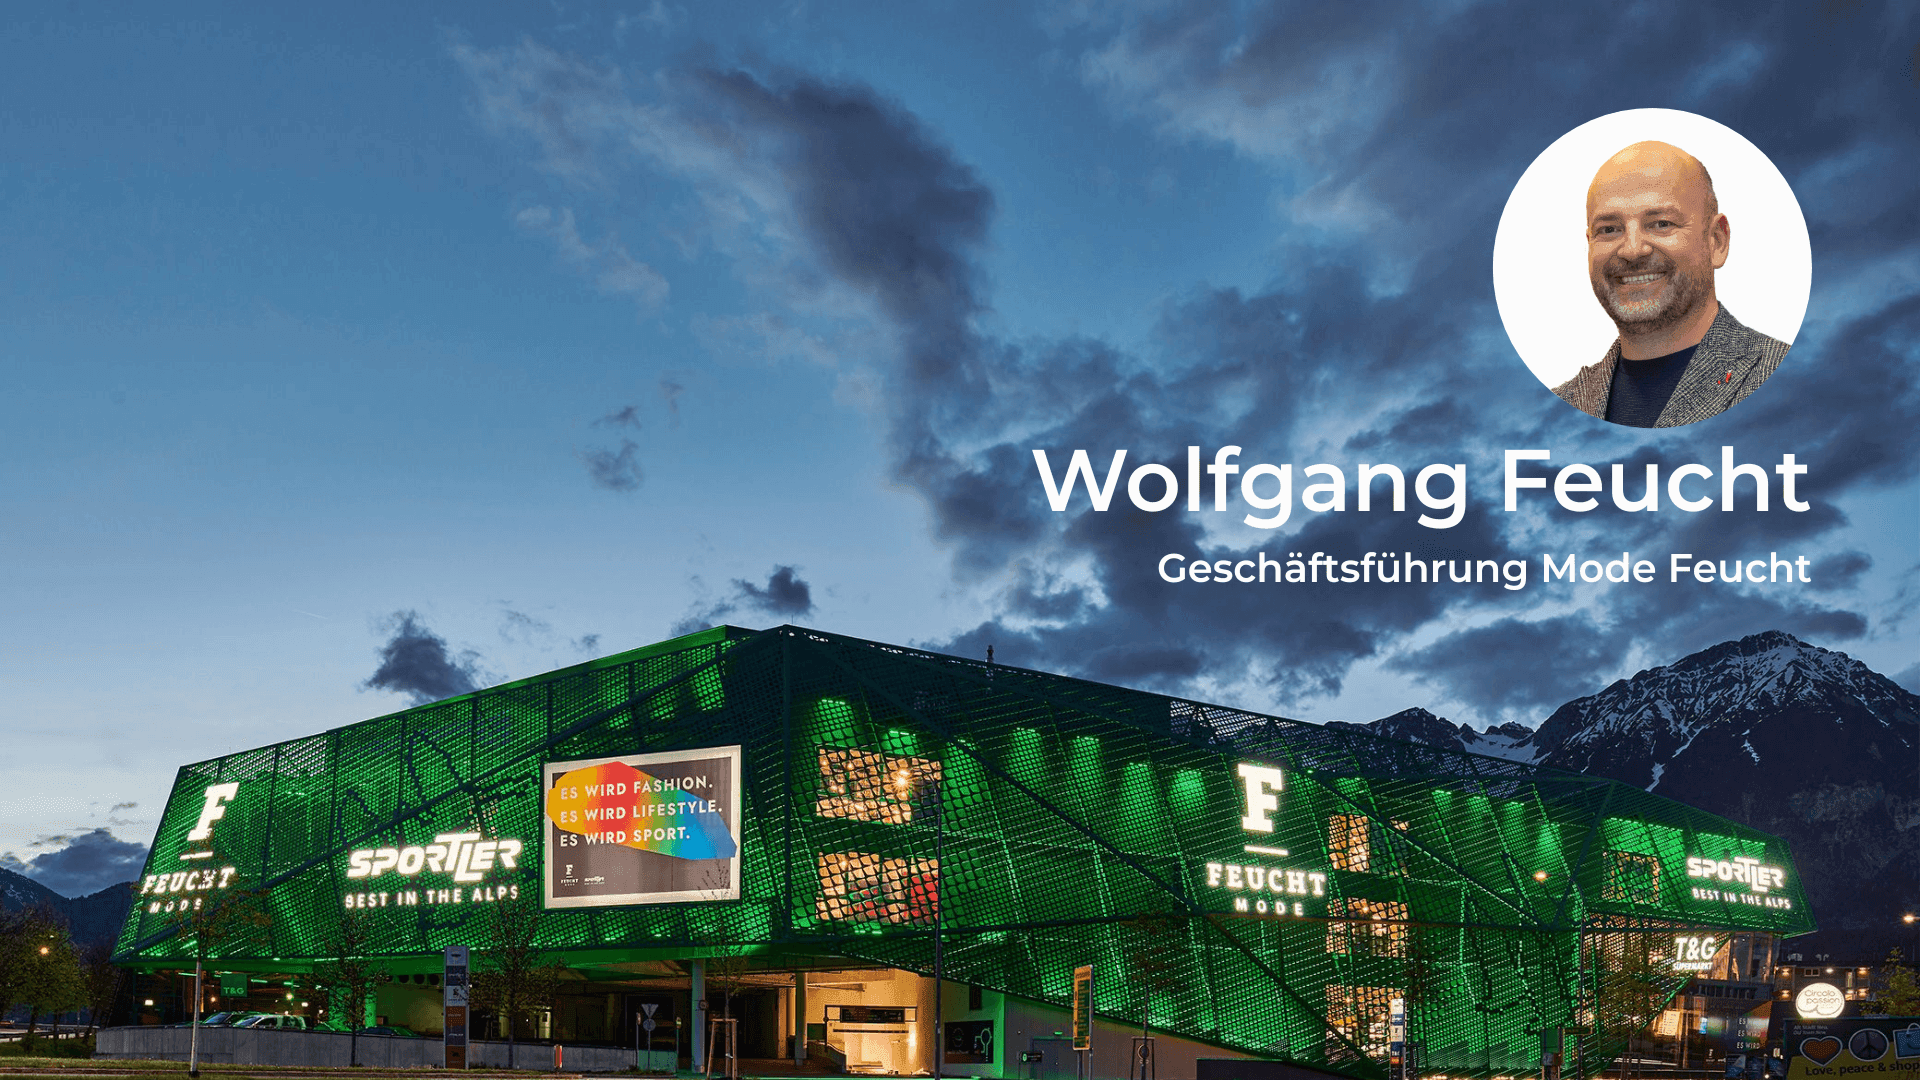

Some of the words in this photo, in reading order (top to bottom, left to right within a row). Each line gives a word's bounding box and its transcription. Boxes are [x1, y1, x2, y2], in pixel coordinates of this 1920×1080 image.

[560, 786, 578, 800] ES
[585, 783, 626, 798] WIRD
[633, 775, 714, 794] FASHION.
[1237, 763, 1283, 833] F
[187, 781, 240, 842] F
[560, 810, 578, 824] ES
[584, 806, 626, 822] WIRD
[633, 799, 723, 818] LIFESTYLE.
[560, 834, 578, 847] ES
[584, 830, 627, 846] WIRD
[633, 826, 691, 843] SPORT.
[347, 832, 523, 882] SPORTLER
[1206, 861, 1326, 896] FEUCHT
[1686, 857, 1785, 893] SPORTLER
[345, 892, 388, 909] BEST
[397, 891, 417, 906] IN
[426, 888, 462, 904] THE
[472, 885, 519, 902] ALPS
[1235, 898, 1304, 916] MODE
[1692, 887, 1720, 900] BEST
[1724, 892, 1737, 903] IN
[1740, 893, 1762, 906] THE
[1765, 896, 1791, 910] ALPS
[1675, 936, 1716, 960] T&G
[223, 987, 245, 995] T&G
[1805, 1066, 1837, 1076] Love,
[1840, 1063, 1875, 1077] peace
[1878, 1062, 1886, 1072] &
